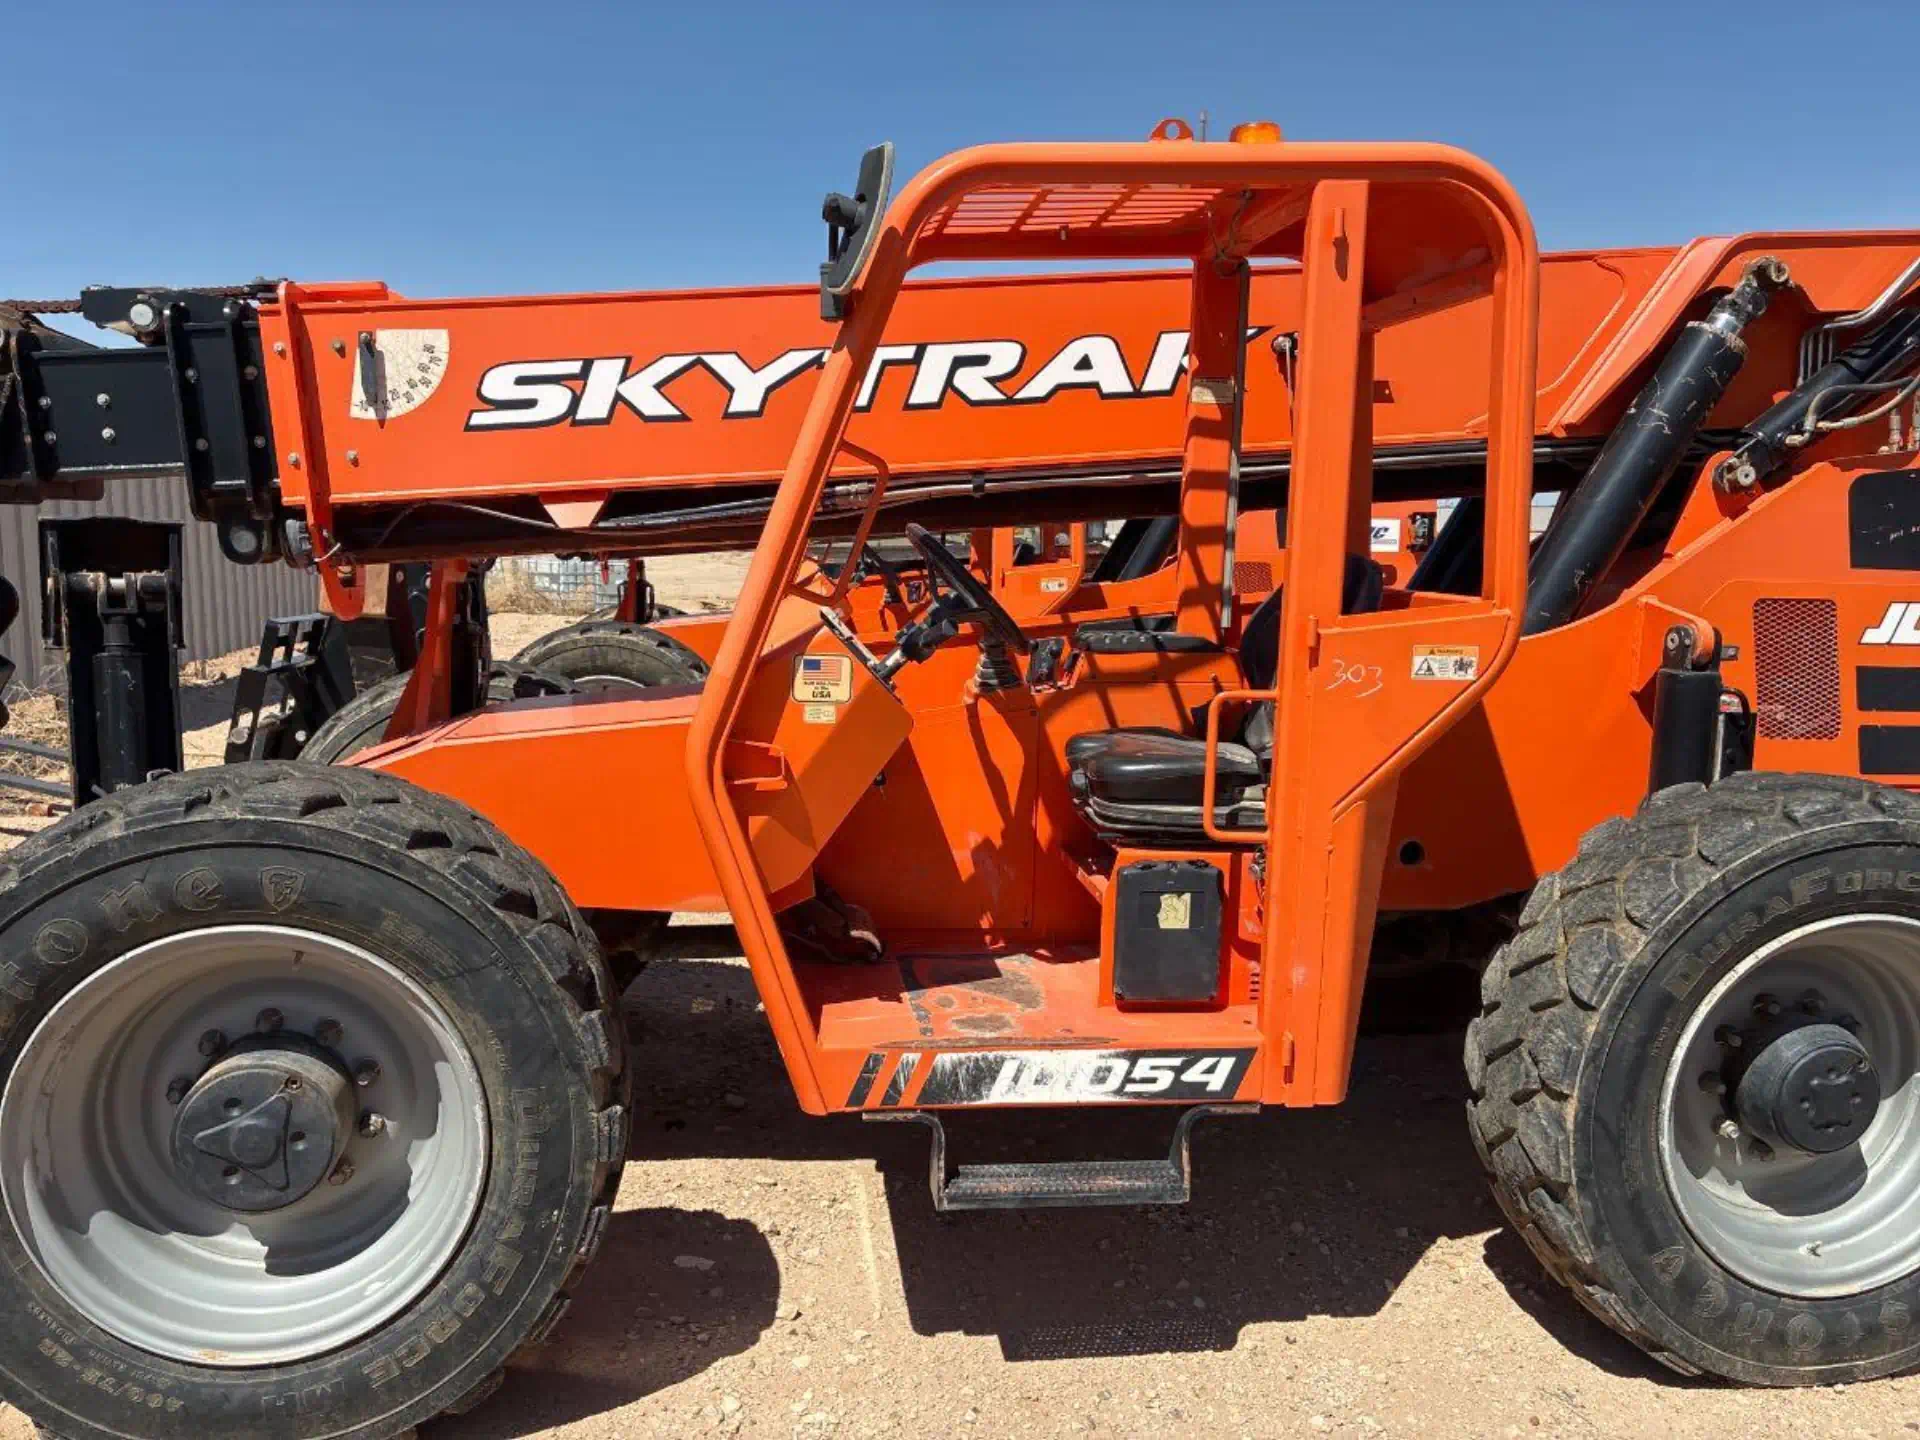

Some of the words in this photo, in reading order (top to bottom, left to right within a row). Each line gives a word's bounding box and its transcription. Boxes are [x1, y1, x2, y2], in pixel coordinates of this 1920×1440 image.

[812, 690, 832, 699] USA
[1324, 659, 1383, 698] 303
[988, 1056, 1238, 1104] 10054
